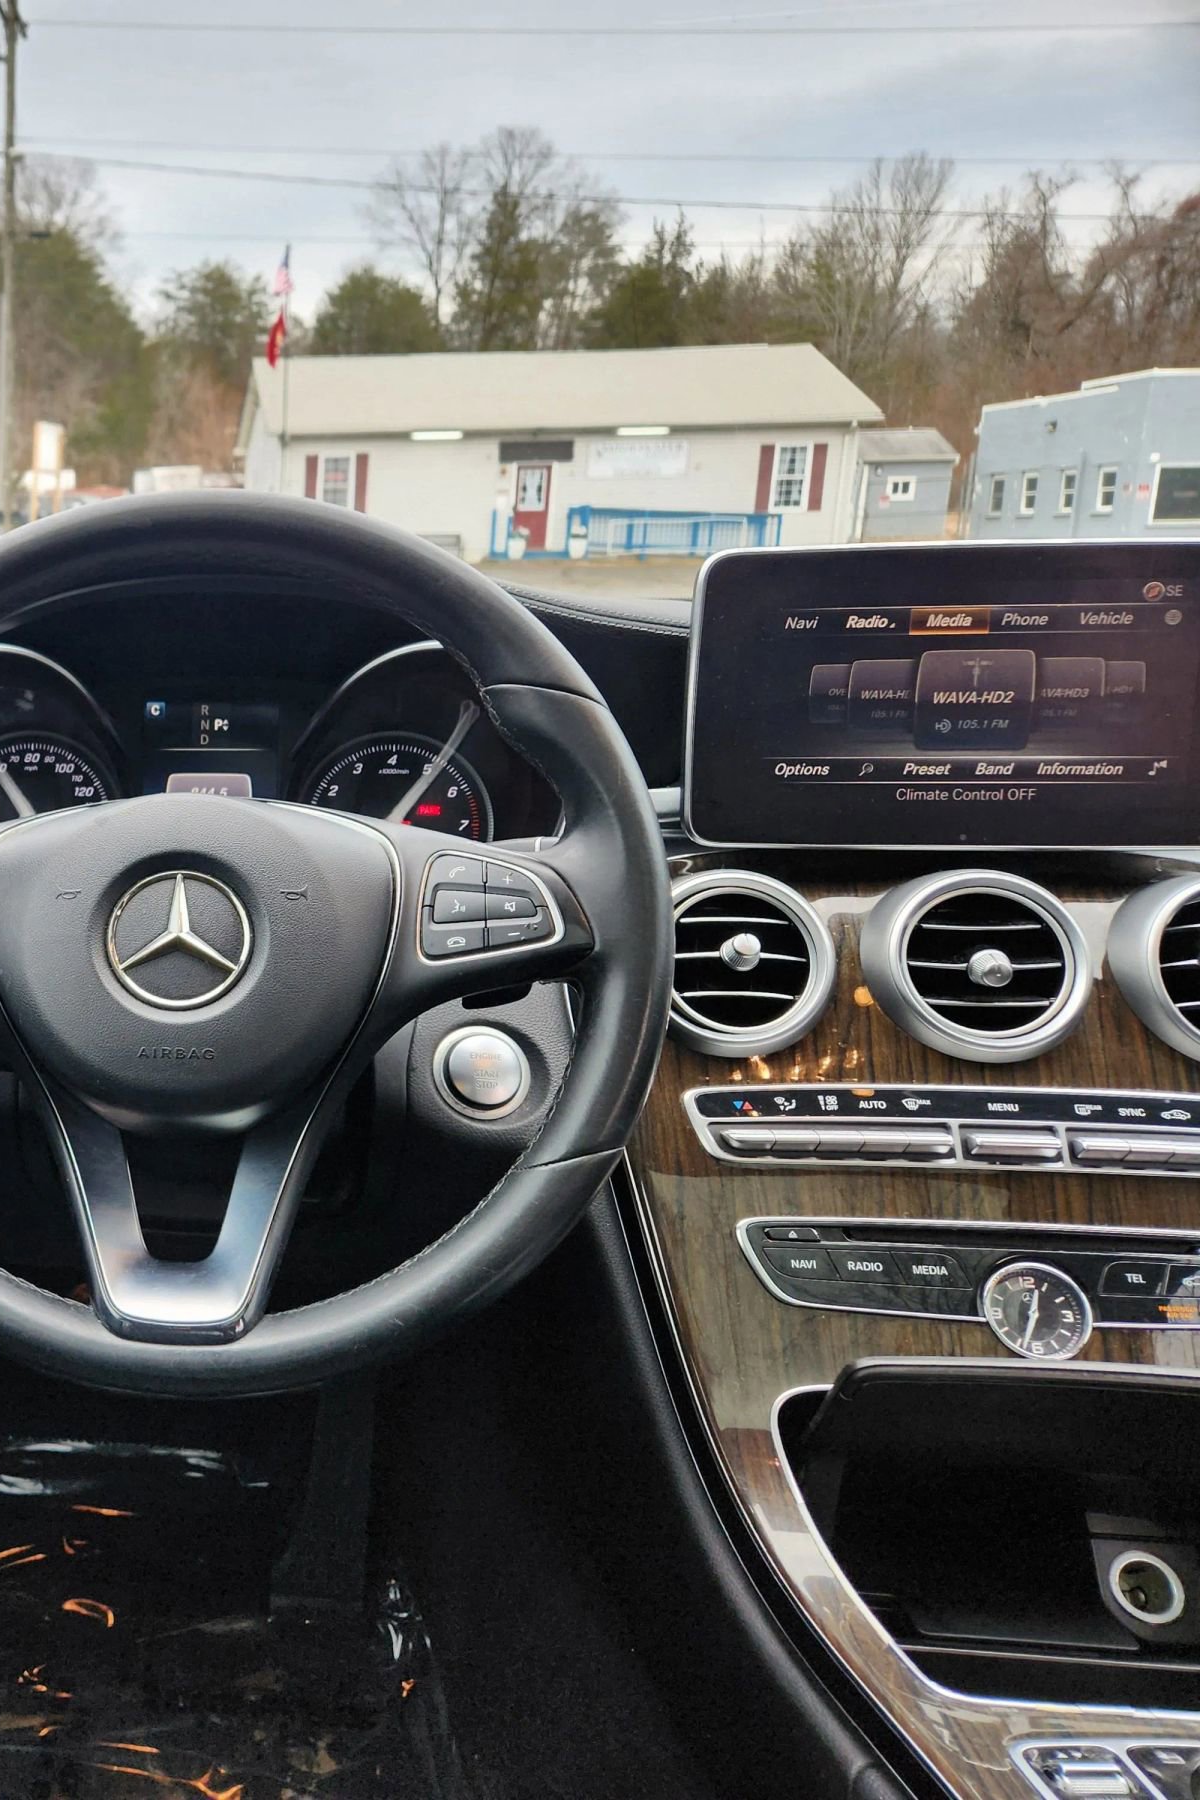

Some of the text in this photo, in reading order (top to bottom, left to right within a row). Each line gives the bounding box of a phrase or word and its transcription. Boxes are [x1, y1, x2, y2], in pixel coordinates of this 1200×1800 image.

[1166, 584, 1184, 597] SE
[784, 611, 1134, 630] Navi Radio Media Phone Vehicle
[933, 691, 1015, 704] WAVA-HD2
[150, 704, 161, 715] C
[201, 704, 209, 716] R
[200, 718, 223, 731] N P
[957, 719, 988, 729] 105.1
[991, 719, 1010, 729] FM
[200, 734, 209, 745] D
[9, 755, 20, 763] 70
[24, 753, 41, 763] 80
[44, 755, 55, 763] 90
[387, 754, 398, 765] 4
[55, 763, 75, 773] 100
[352, 763, 364, 774] 3
[422, 763, 434, 775] 5
[774, 762, 1124, 778] Options Preset Band Information
[71, 774, 83, 782] 110
[74, 786, 94, 797] 120
[327, 784, 339, 796] 2
[447, 786, 458, 798] 6
[896, 788, 1037, 801] Climate Control OFF
[458, 819, 470, 831] 7
[135, 1046, 217, 1060] AIRBAG
[475, 1080, 498, 1089] STOP
[858, 1100, 887, 1109] AUTO
[987, 1102, 1019, 1112] MENU
[1117, 1107, 1146, 1117] SYNC
[790, 1259, 817, 1269] NAVI
[846, 1261, 883, 1272] RADIO
[911, 1265, 948, 1276] MEDIA
[1018, 1276, 1036, 1288] 12
[1124, 1273, 1147, 1284] TEL
[1060, 1310, 1074, 1322] 3
[1031, 1342, 1045, 1354] 6
